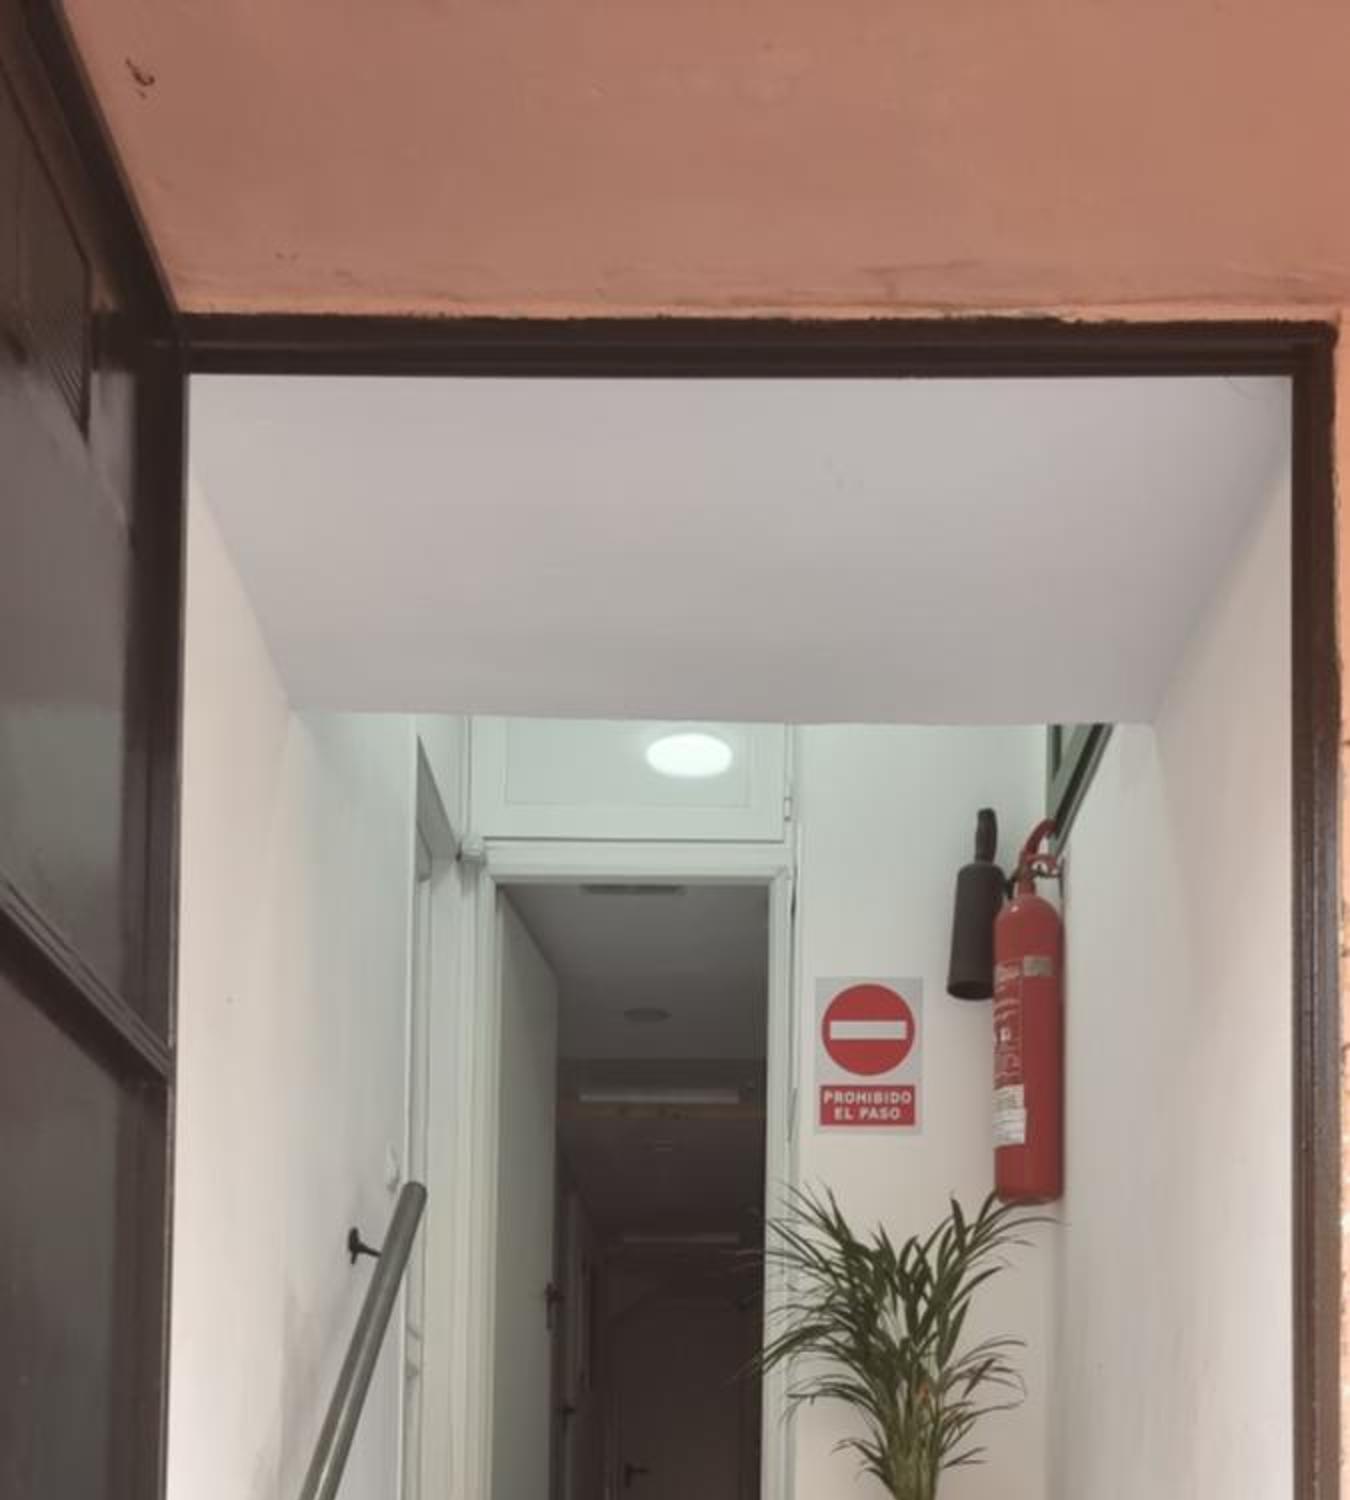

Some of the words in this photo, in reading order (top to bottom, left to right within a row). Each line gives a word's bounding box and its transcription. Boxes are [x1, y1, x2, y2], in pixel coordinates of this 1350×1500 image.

[823, 1090, 912, 1104] PROHIBIDO
[834, 1106, 855, 1120] EL
[860, 1106, 901, 1120] PASO
